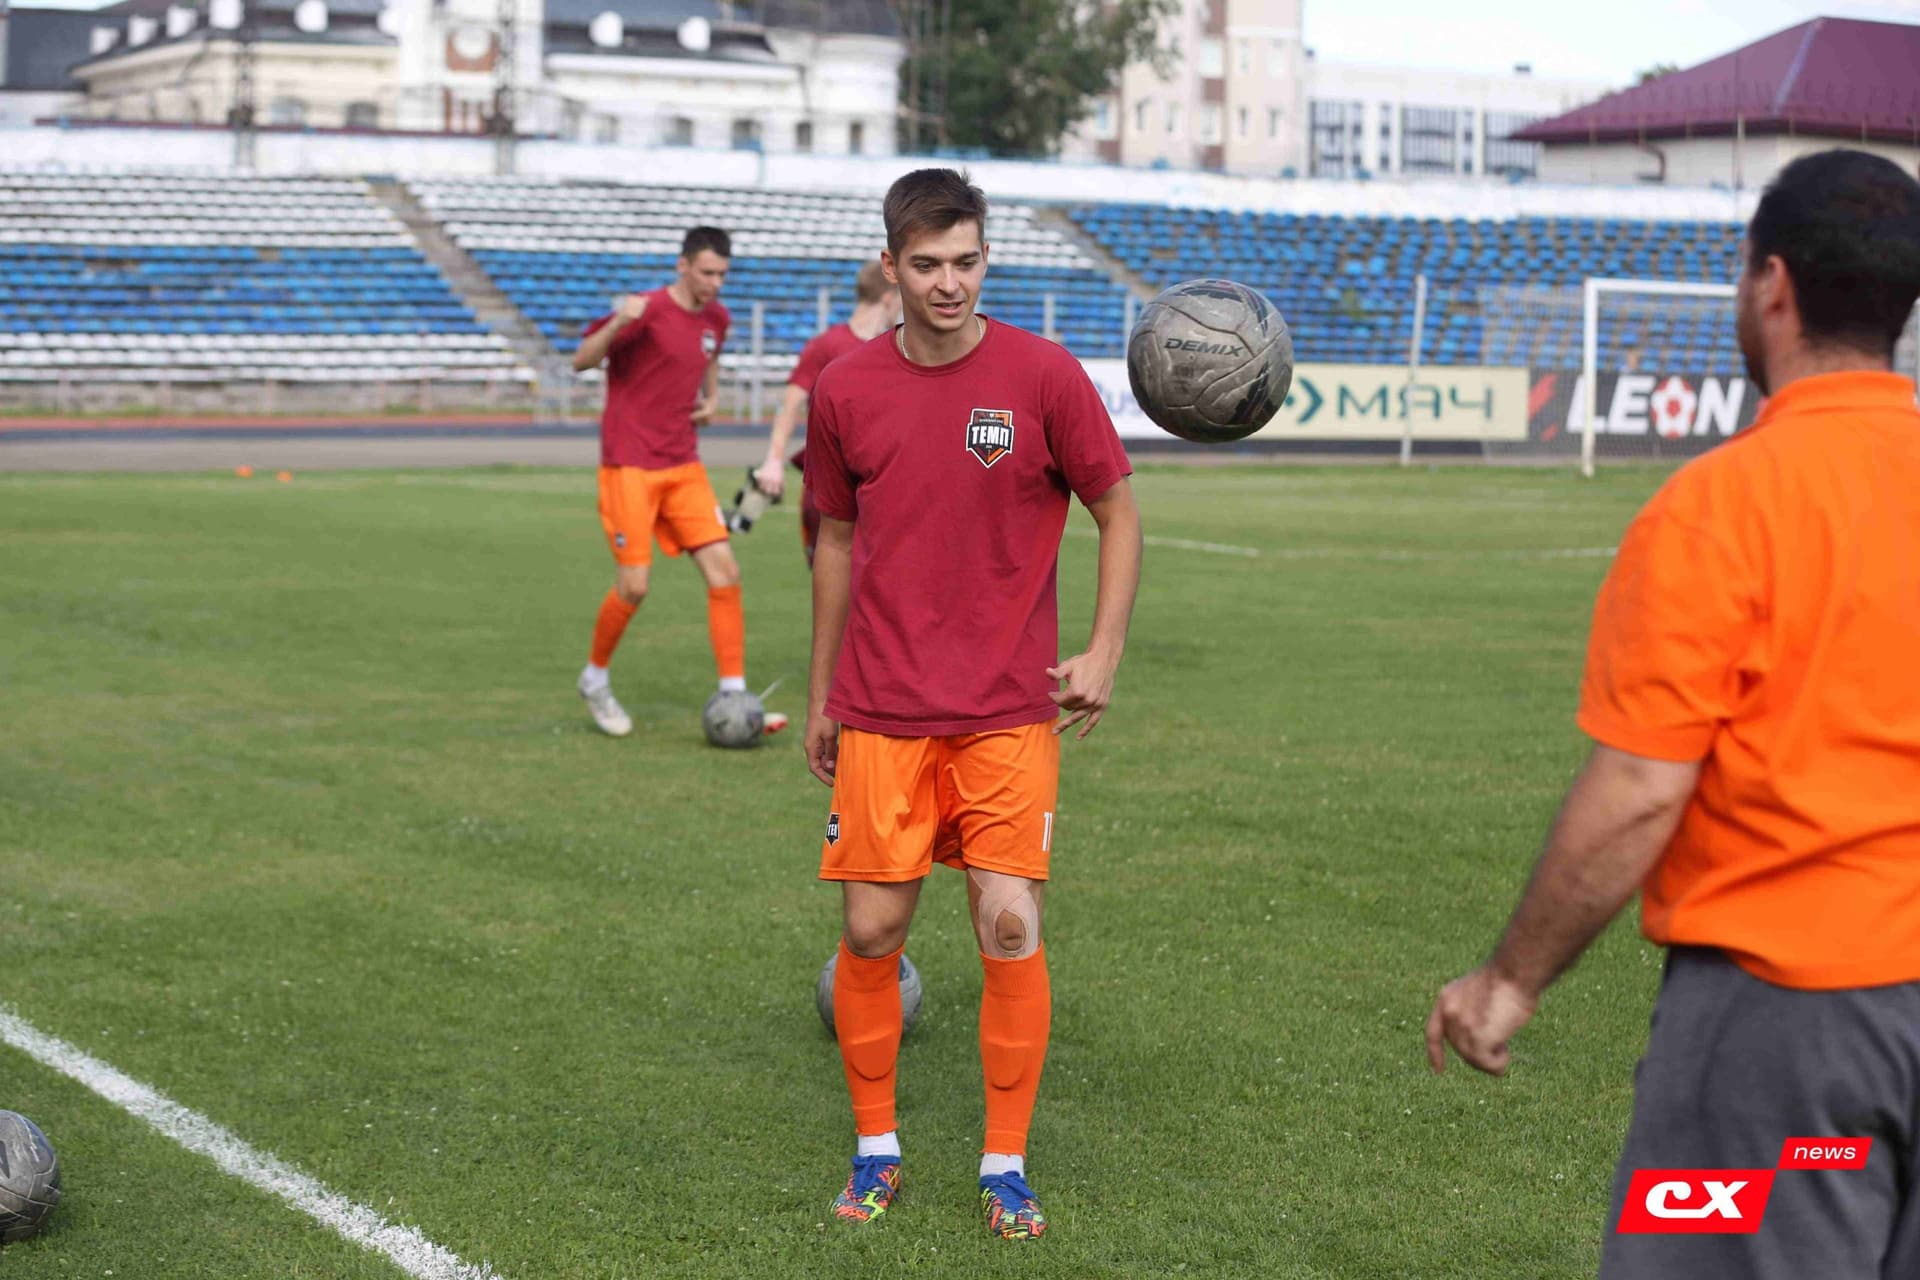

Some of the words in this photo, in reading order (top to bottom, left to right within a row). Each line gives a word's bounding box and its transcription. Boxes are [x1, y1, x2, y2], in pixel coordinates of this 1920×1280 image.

[1164, 338, 1243, 357] DEMIX
[1337, 384, 1492, 420] МЯЧ
[1566, 375, 1746, 439] LEON
[972, 425, 1009, 447] ТЕМП
